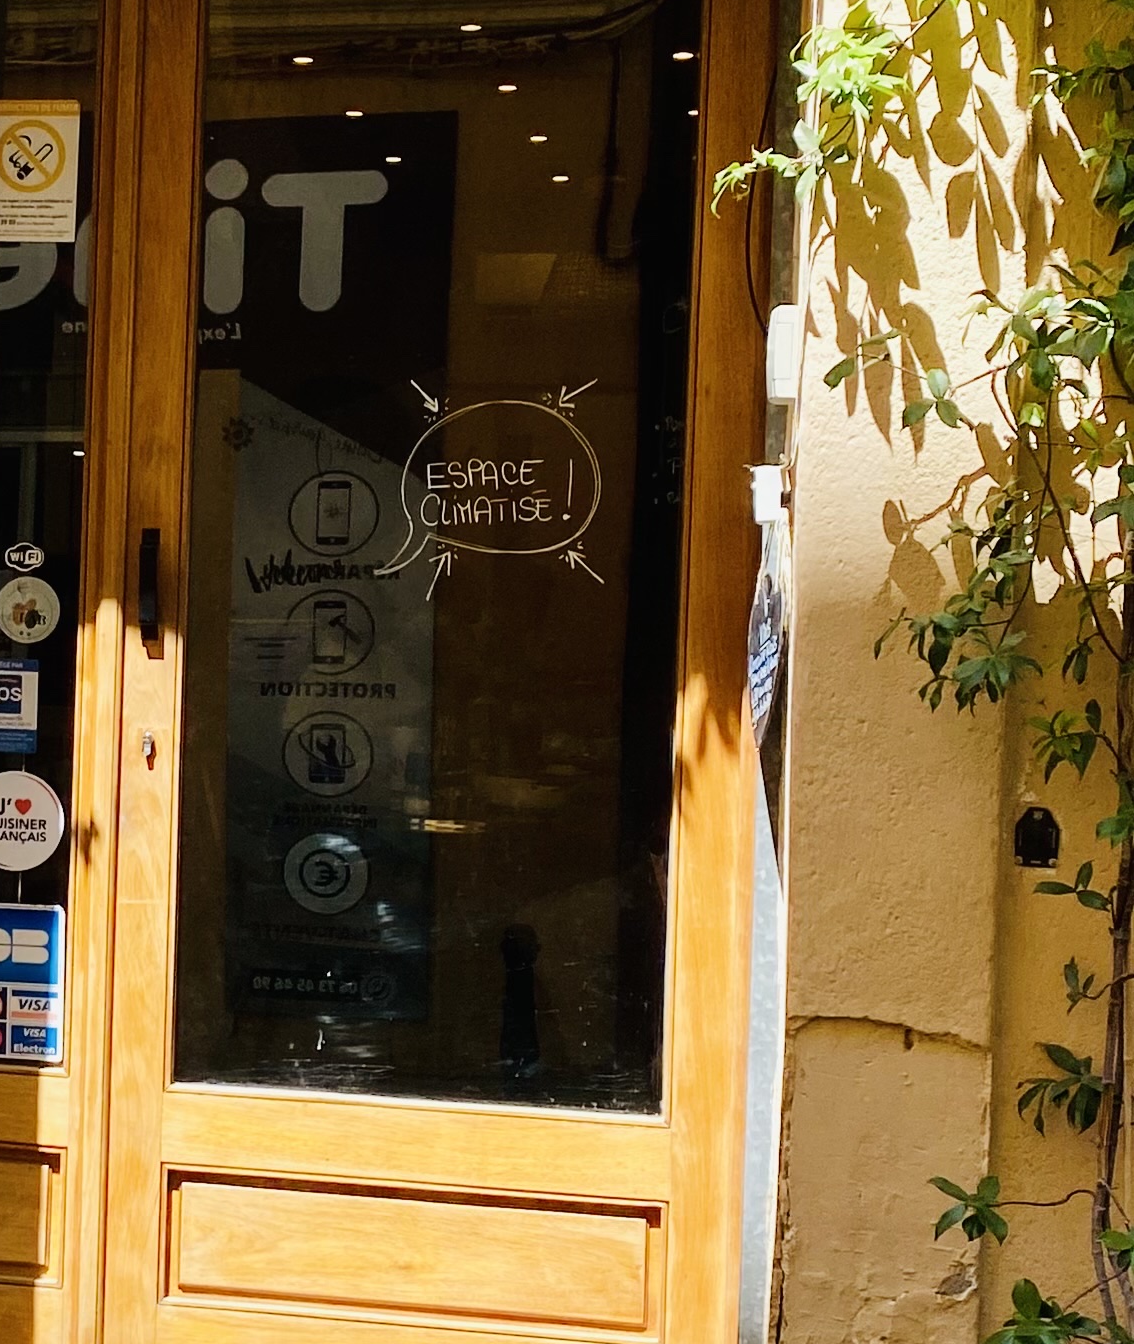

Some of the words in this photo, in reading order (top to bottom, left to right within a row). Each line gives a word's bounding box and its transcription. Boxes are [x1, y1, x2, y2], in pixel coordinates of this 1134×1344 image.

[426, 459, 545, 490] ESPACE
[18, 998, 51, 1011] VISA
[23, 1028, 47, 1038] VISA
[13, 1043, 56, 1055] Electron
